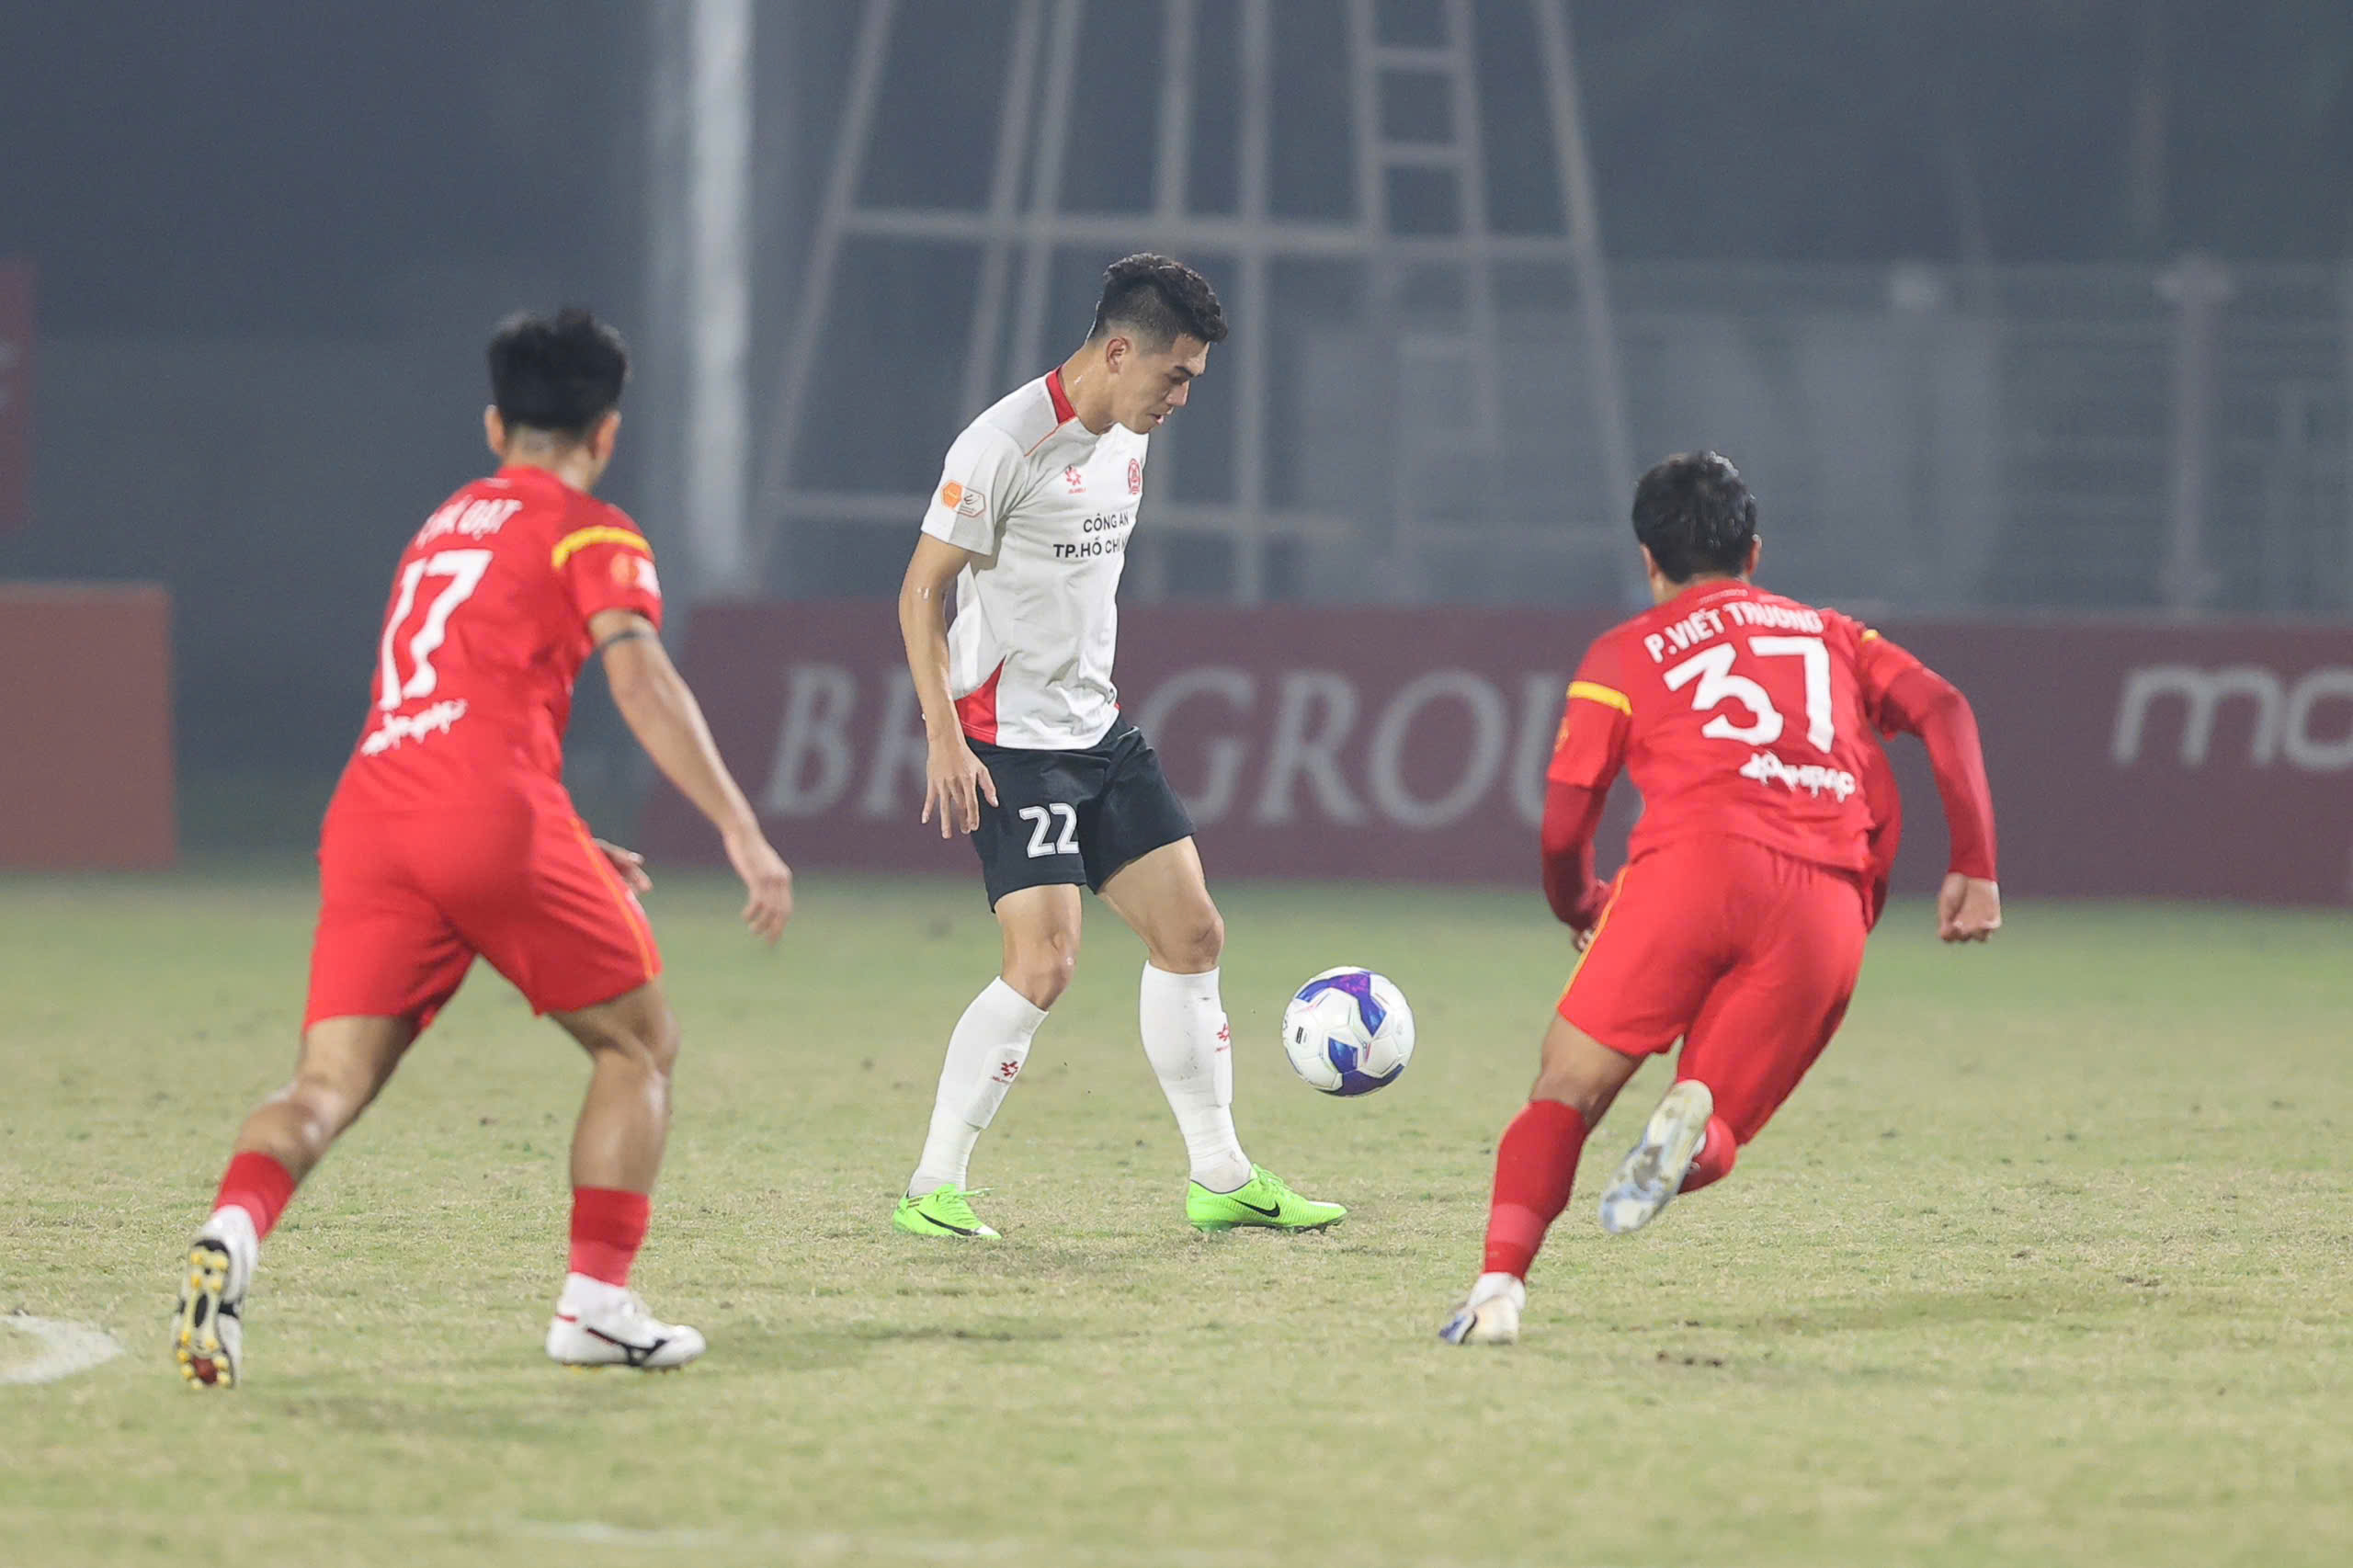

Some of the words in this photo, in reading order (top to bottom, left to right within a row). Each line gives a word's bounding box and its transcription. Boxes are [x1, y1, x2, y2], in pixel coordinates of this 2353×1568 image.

[1052, 535, 1102, 558] TP.HỒ
[1083, 512, 1118, 533] CÔNG
[1119, 510, 1130, 528] AN
[378, 549, 494, 711] 17
[1663, 634, 1836, 754] 37
[1018, 802, 1080, 858] 22
